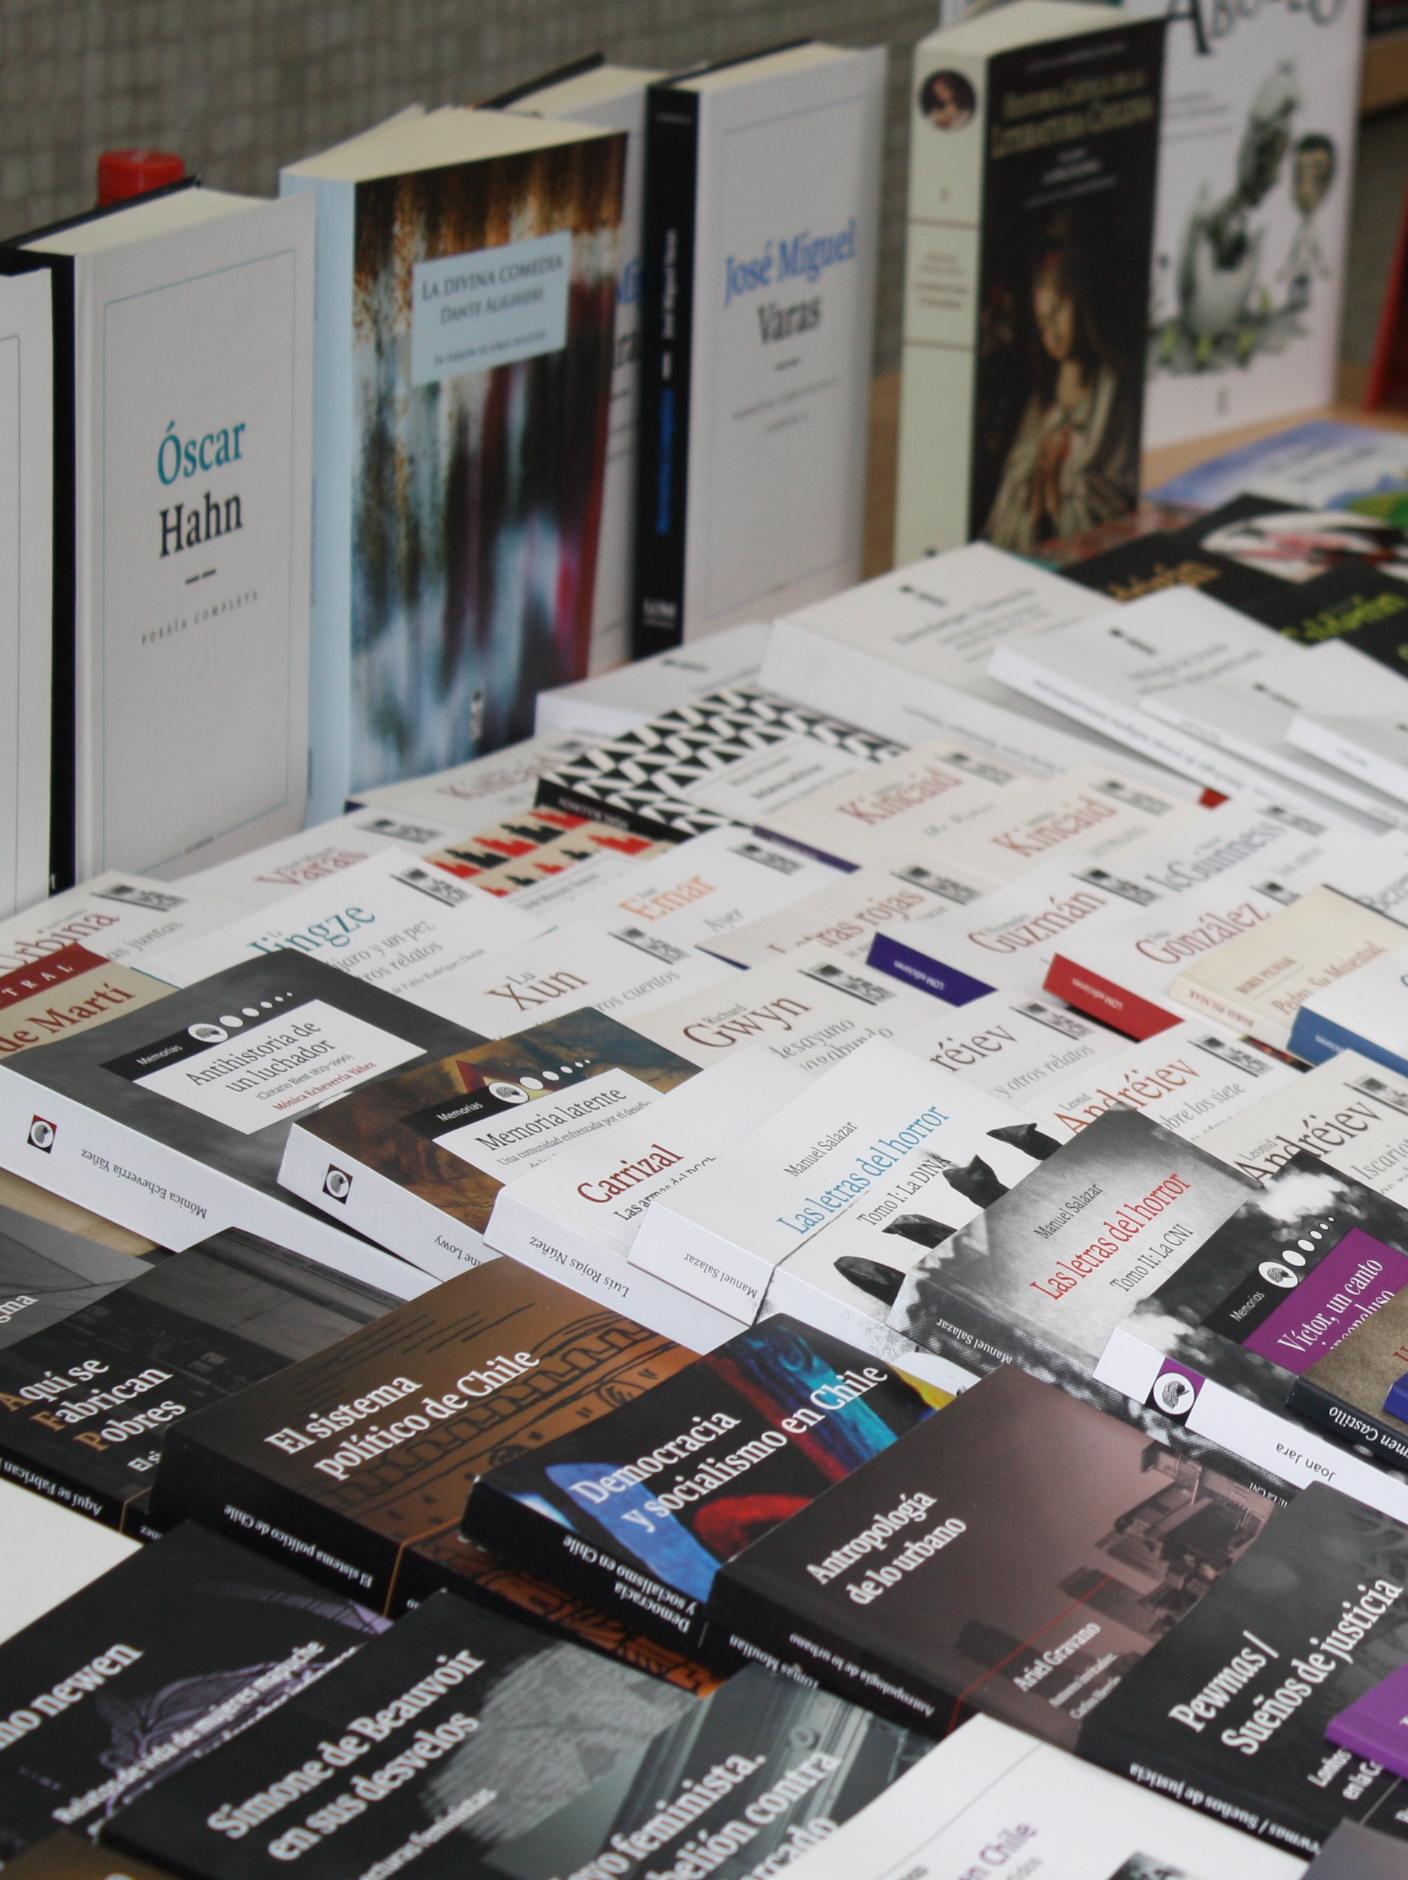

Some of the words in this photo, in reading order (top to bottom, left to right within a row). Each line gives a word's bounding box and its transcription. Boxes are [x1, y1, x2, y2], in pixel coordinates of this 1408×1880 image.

[444, 271, 496, 297] DIVINA
[499, 254, 564, 284] COMEDIA
[723, 238, 775, 309] José
[778, 218, 858, 283] Miguel
[758, 296, 822, 346] Varas
[158, 420, 246, 485] Óscar
[159, 489, 243, 559] Hahn
[836, 766, 963, 826] Kincaid
[991, 793, 1118, 857] Kincaid
[618, 875, 719, 922] Emar
[968, 895, 1104, 955] Guzmán
[392, 941, 443, 972] relatos
[1135, 902, 1271, 965] González
[26, 982, 136, 1034] Martí
[483, 969, 590, 1011] Xun
[621, 970, 681, 1000] cuentos
[682, 997, 812, 1048] Gwyn
[702, 1003, 747, 1026] Richard
[136, 1044, 183, 1066] Memorias
[185, 1034, 295, 1087] Antihistoria
[293, 1021, 322, 1042] de
[247, 1037, 336, 1088] luchador
[436, 1102, 483, 1122] Memorias
[474, 1111, 565, 1153] Memoria
[562, 1086, 628, 1124] latente
[80, 1148, 111, 1173] Yáñez
[577, 1144, 684, 1204] Carrizal
[777, 1208, 821, 1234] Las
[814, 1173, 870, 1213] letras
[858, 1140, 896, 1178] del
[887, 1104, 951, 1155] horror
[783, 1144, 826, 1178] Manuel
[824, 1119, 859, 1154] Salazar
[112, 1164, 167, 1200] Echeverría
[167, 1190, 208, 1219] Mónica
[613, 1199, 642, 1222] Las
[1034, 1205, 1077, 1240] Manuel
[1065, 1181, 1104, 1221] Salazar
[529, 1236, 570, 1266] Núñez
[1030, 1261, 1078, 1300] Las
[1065, 1230, 1121, 1278] letras
[1103, 1212, 1145, 1245] del
[1133, 1172, 1191, 1225] horror
[565, 1256, 603, 1284] Rojas
[598, 1274, 630, 1299] Luis
[683, 1253, 723, 1281] Salazar
[719, 1271, 758, 1299] Manuel
[1229, 1290, 1265, 1322] Memorias
[1277, 1308, 1337, 1353] Víctor,
[1330, 1289, 1354, 1313] un
[1344, 1258, 1383, 1296] canto
[0, 1371, 75, 1413] Aquí
[67, 1357, 110, 1383] se
[30, 1365, 174, 1432] Fabrican
[73, 1398, 187, 1454] Pobres
[263, 1427, 313, 1456] El
[308, 1373, 424, 1443] sistema
[313, 1411, 432, 1481] político
[421, 1393, 469, 1422] de
[456, 1349, 541, 1400] Chile
[1328, 1405, 1379, 1442] Castillo
[570, 1408, 742, 1503] Democracia
[621, 1509, 655, 1534] y
[644, 1430, 789, 1520] socialismo
[780, 1404, 826, 1436] en
[810, 1365, 889, 1413] Chile
[1274, 1442, 1305, 1463] Jara
[1302, 1458, 1336, 1481] Joan
[805, 1488, 938, 1586] Antropología
[845, 1576, 876, 1604] de
[872, 1562, 902, 1589] lo
[898, 1517, 967, 1574] urbano
[614, 1582, 691, 1634] Democracia
[1310, 1578, 1404, 1663] justicia
[32, 1643, 144, 1718] newen
[1012, 1660, 1045, 1694] Ariel
[1039, 1622, 1102, 1668] Gravano
[1296, 1636, 1336, 1683] de
[207, 1757, 336, 1840] Simone
[319, 1720, 372, 1768] de
[347, 1647, 485, 1742] Beauvoir
[1220, 1674, 1313, 1756] Sueños
[268, 1830, 321, 1861] en
[305, 1794, 368, 1834] sus
[350, 1712, 479, 1804] desvelos
[743, 1749, 841, 1826] contra
